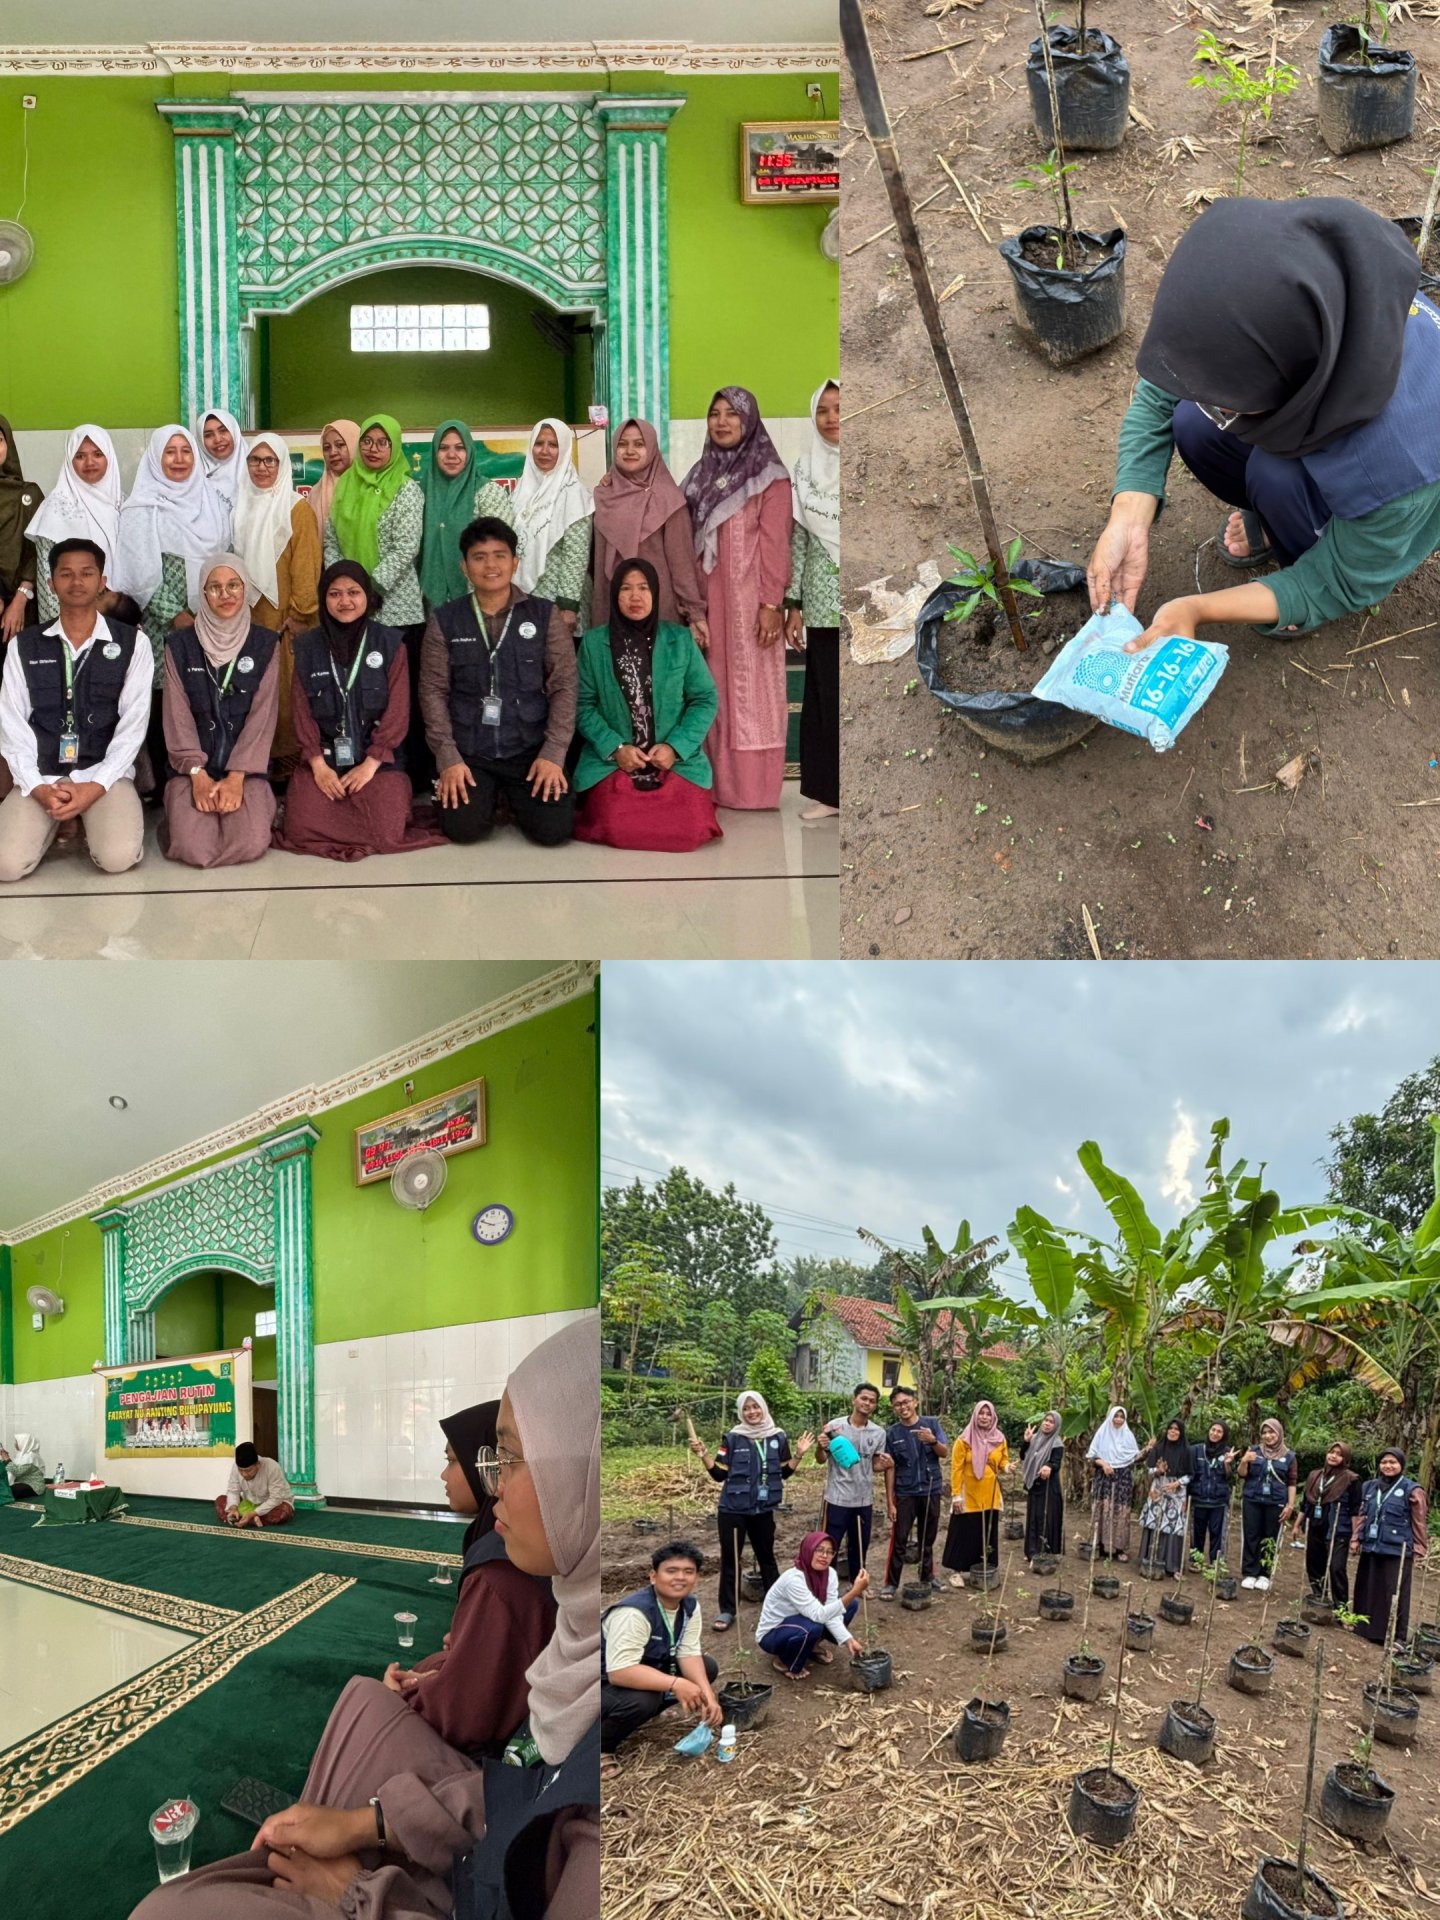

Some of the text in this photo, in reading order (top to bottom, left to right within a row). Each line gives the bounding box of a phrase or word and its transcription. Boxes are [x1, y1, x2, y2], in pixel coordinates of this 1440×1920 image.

[1119, 654, 1151, 704] Mutiara
[1140, 641, 1197, 710] 16-16-16
[119, 1383, 216, 1406] PENGAJIAN RUTIN
[107, 1401, 232, 1421] FATAYAT NU RANTING BULUPAYUNG
[155, 1803, 186, 1824] Vit
